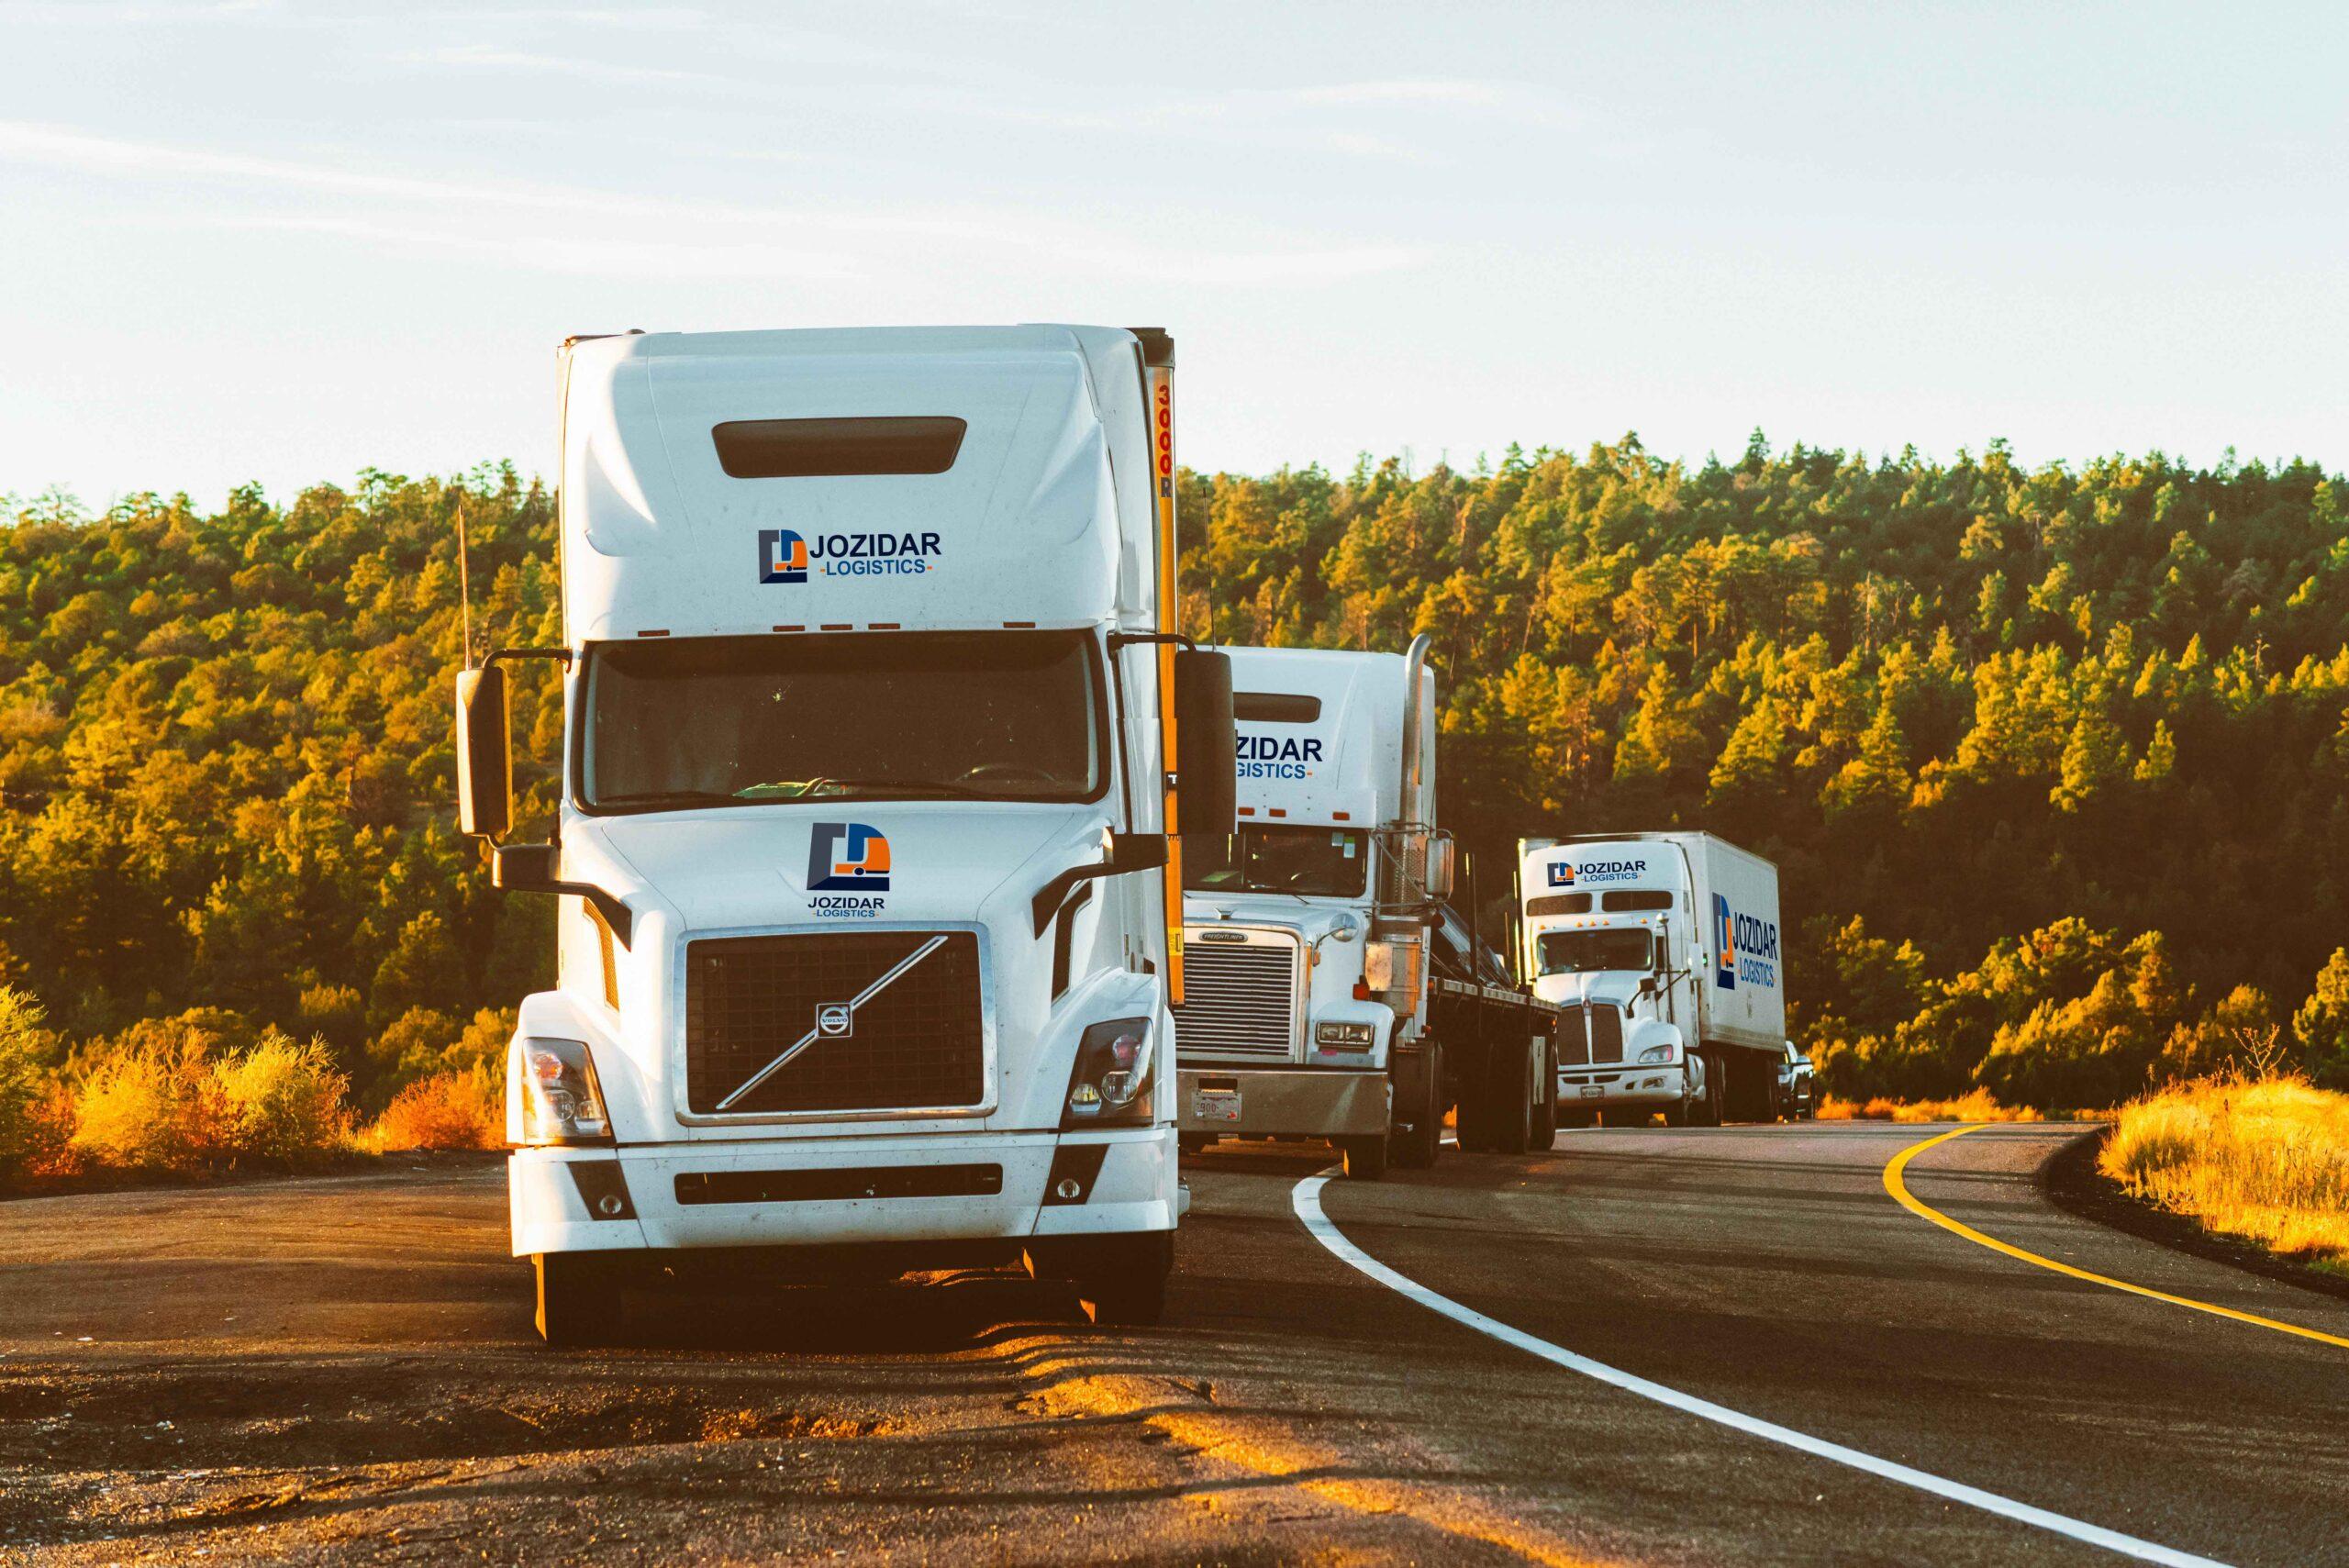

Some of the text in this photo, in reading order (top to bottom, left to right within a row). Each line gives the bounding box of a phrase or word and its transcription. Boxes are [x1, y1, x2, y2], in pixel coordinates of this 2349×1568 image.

[809, 532, 941, 559] JOZIDAR
[1237, 737, 1323, 762] ZIDAR
[1575, 861, 1646, 874] JOZIDAR
[807, 897, 885, 909] JOZIDAR
[1733, 911, 1778, 961] JOZIDAR
